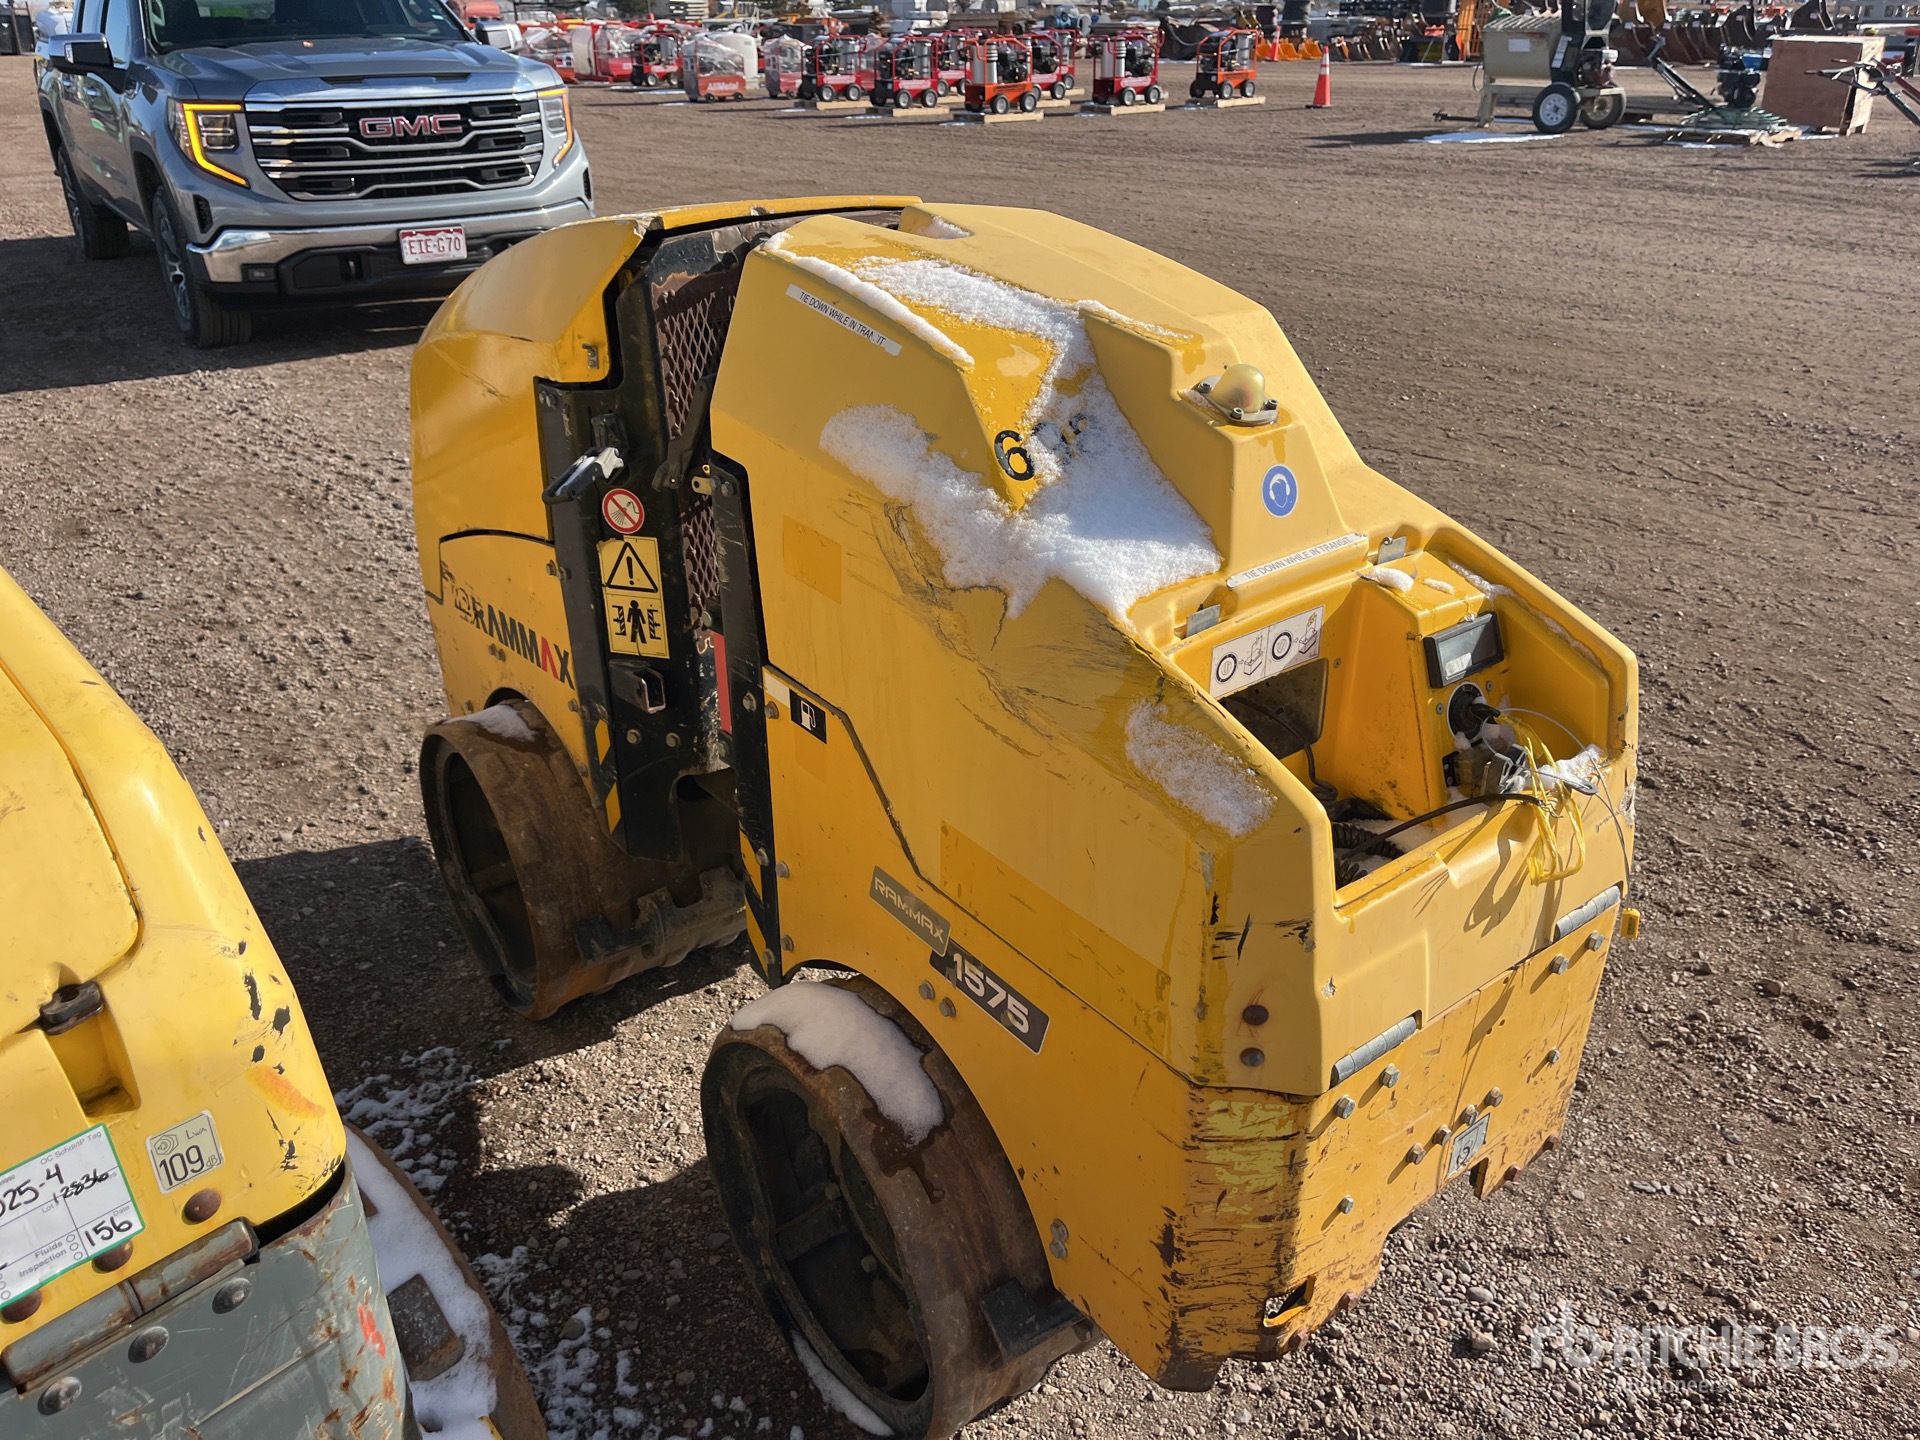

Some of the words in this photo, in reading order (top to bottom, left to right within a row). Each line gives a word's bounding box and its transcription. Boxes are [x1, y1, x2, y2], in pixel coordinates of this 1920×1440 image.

[359, 113, 463, 138] GMC
[799, 291, 810, 304] TIE
[809, 297, 830, 314] DOWN
[828, 307, 851, 326] WHILE
[849, 320, 857, 330] IN
[857, 323, 887, 346] TRANIT
[1242, 569, 1260, 580] TIE
[1260, 560, 1287, 575] DOWN
[1285, 551, 1311, 566] WHILE
[1310, 548, 1321, 558] IN
[1319, 536, 1354, 552] TRANSIT
[873, 876, 944, 944] RAMMAX
[953, 952, 1030, 1034] 1575
[40, 1154, 54, 1165] OC
[87, 1131, 102, 1142] Tag
[159, 1144, 205, 1186] 109
[205, 1154, 218, 1168] dB
[41, 1204, 54, 1214] Lot
[112, 1204, 131, 1217] Date
[84, 1216, 133, 1247] 156
[18, 1248, 67, 1278] Inspection
[34, 1241, 63, 1259] Fluids
